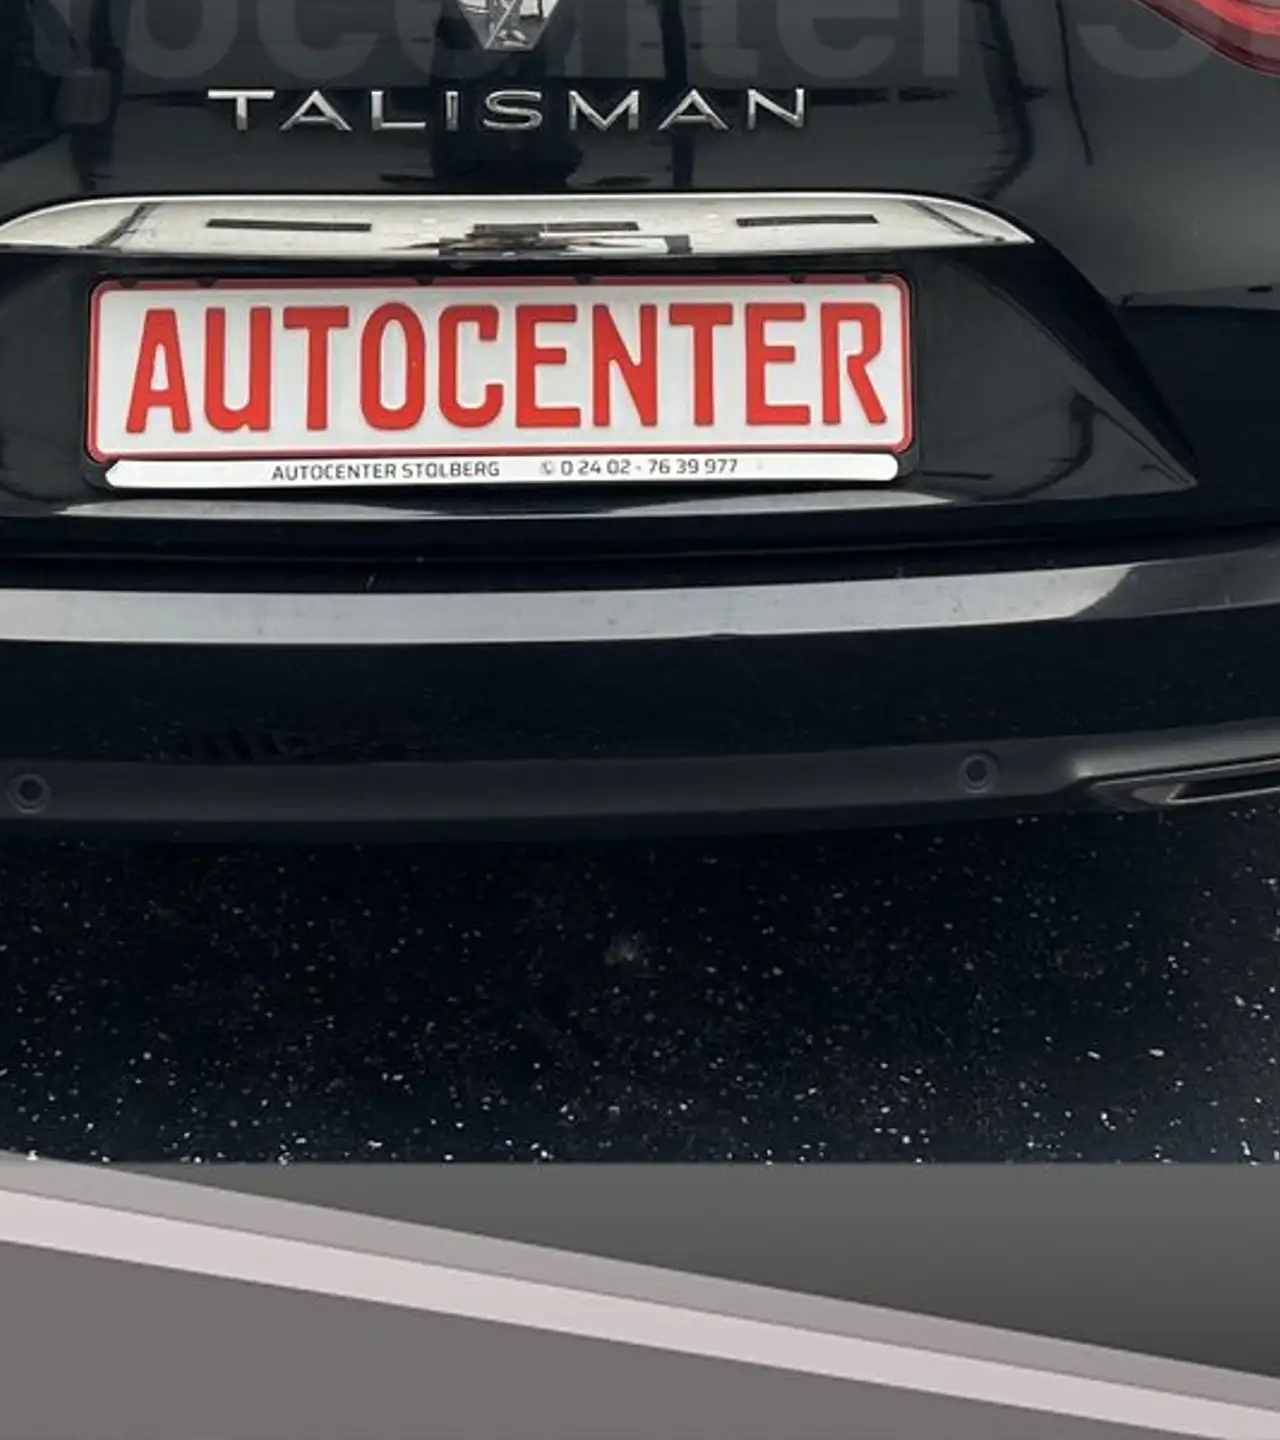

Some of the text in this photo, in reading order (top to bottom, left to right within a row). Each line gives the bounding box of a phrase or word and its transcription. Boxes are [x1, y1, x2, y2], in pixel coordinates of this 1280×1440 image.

[207, 88, 806, 131] TALISMAN
[125, 301, 889, 434] AUTOCENTER
[270, 462, 397, 482] AUTOCENTER
[401, 460, 501, 478] STOLBERG
